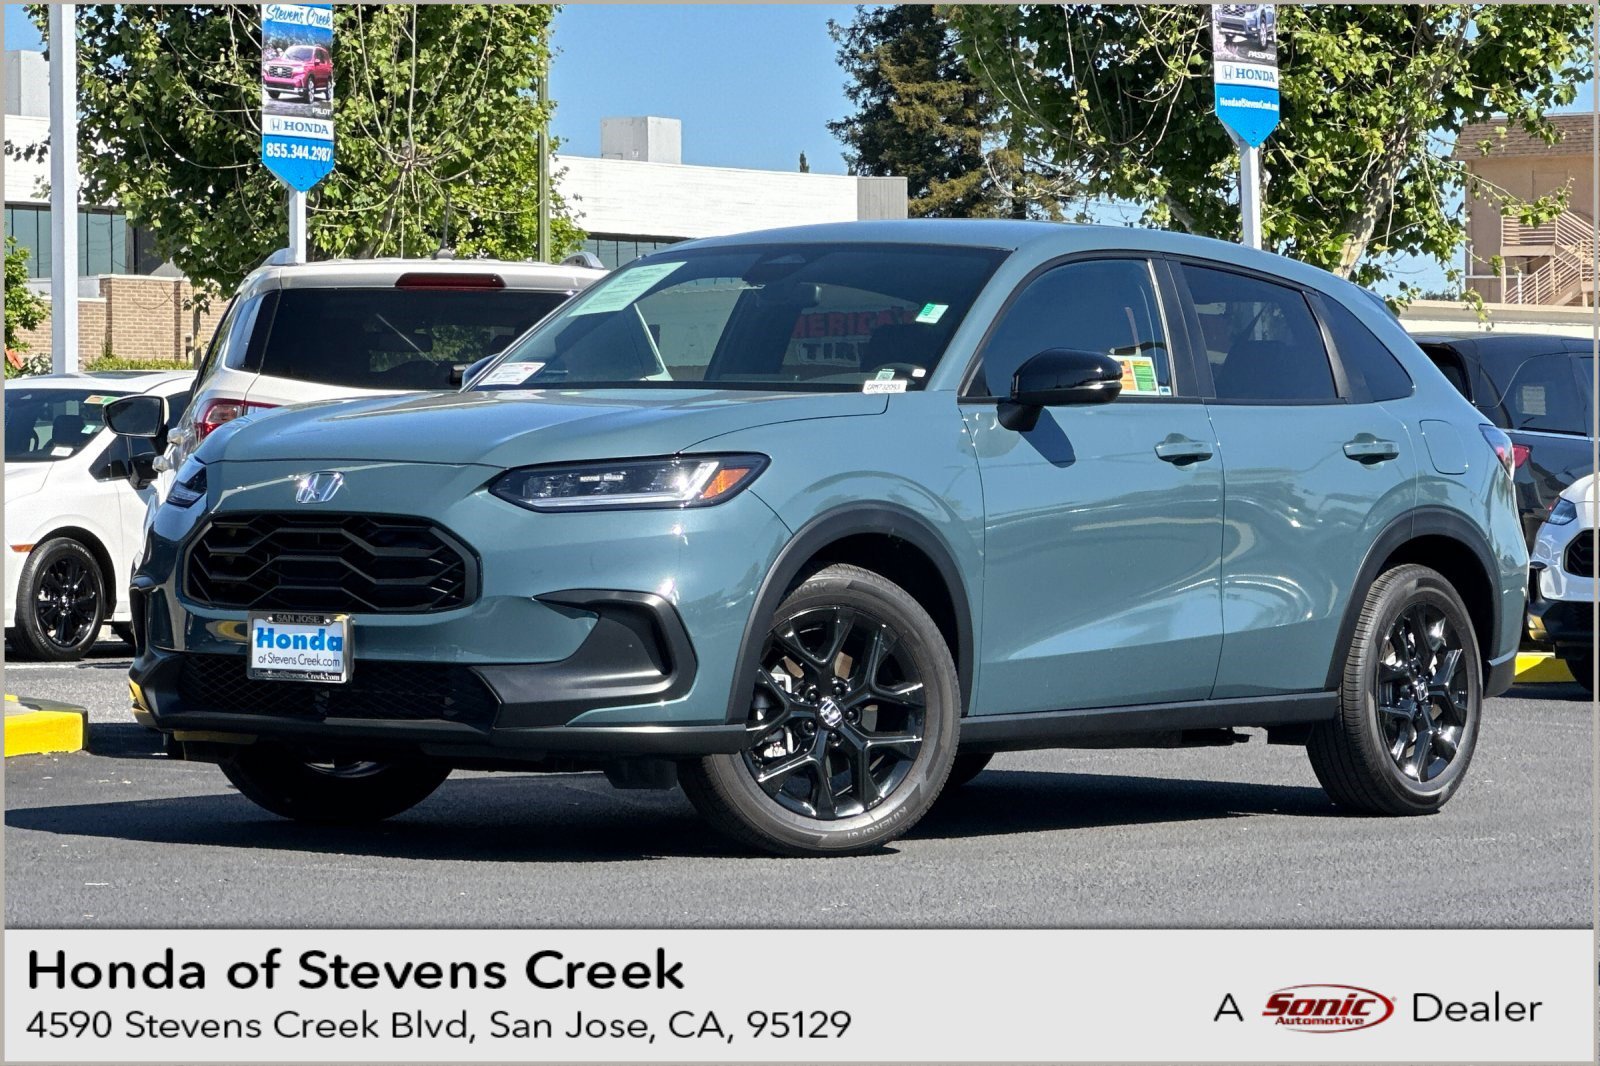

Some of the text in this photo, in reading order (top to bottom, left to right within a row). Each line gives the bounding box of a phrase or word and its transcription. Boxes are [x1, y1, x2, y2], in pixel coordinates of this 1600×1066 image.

[265, 4, 331, 26] Stevens Creek
[1235, 67, 1275, 82] HONDA
[312, 107, 331, 116] PILOT
[284, 121, 329, 134] HONDA
[266, 142, 332, 162] 855.344.2987
[276, 613, 321, 623] SAN JOSE
[257, 627, 343, 651] Honda
[258, 652, 340, 667] of Stevens Creek.com
